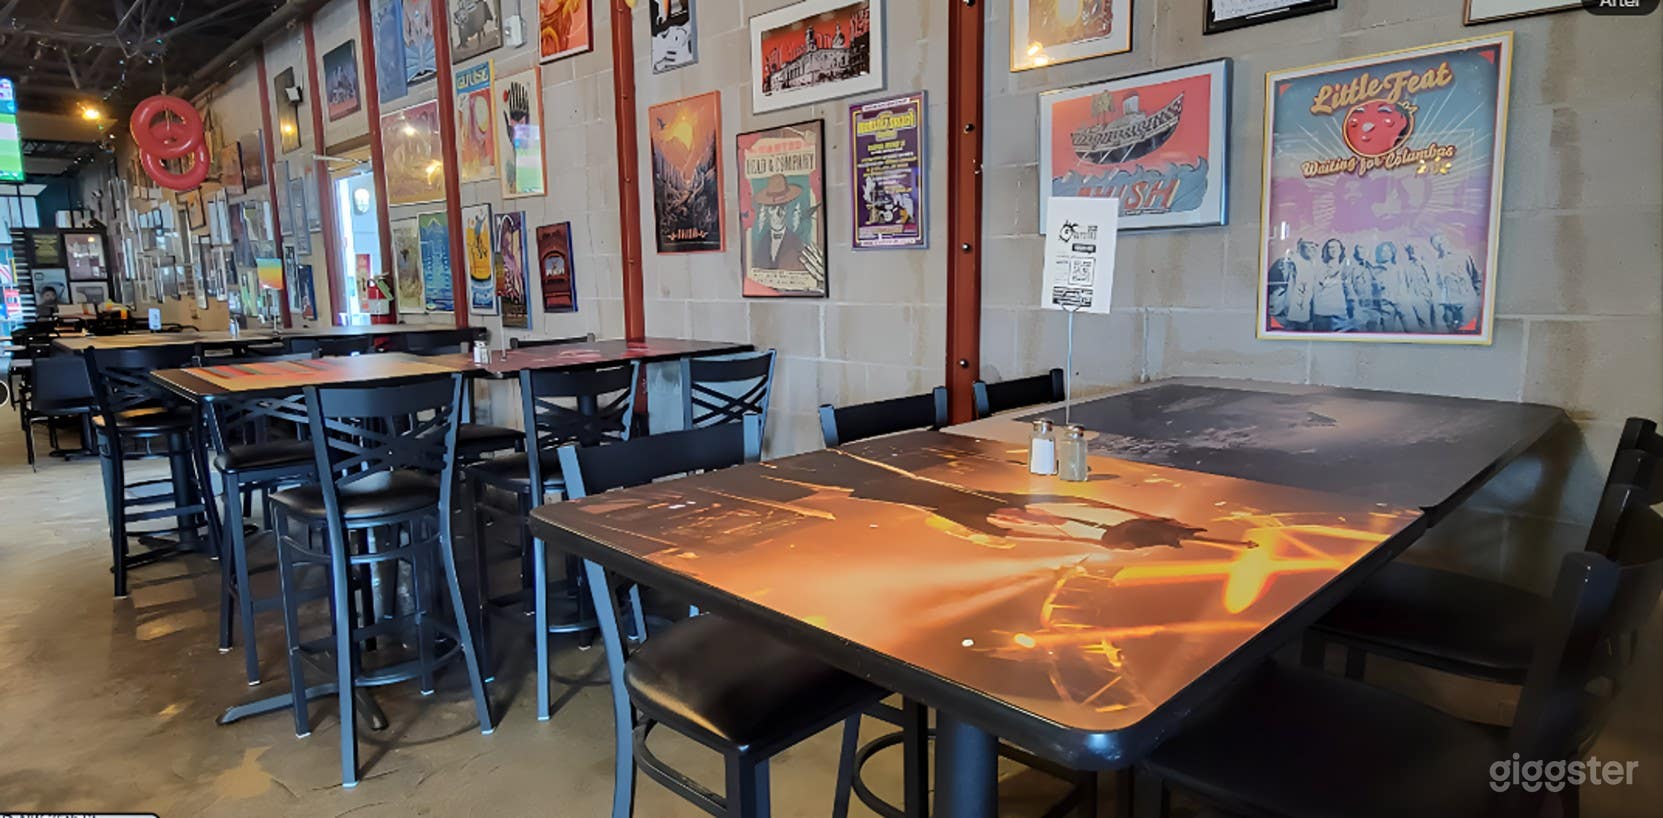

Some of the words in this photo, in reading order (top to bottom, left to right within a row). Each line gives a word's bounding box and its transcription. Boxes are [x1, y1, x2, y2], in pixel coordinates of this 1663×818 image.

[1310, 73, 1383, 115] Little
[1383, 61, 1453, 105] Feat
[775, 152, 815, 174] COMPANY
[1301, 157, 1357, 178] Waiting
[1358, 155, 1384, 178] for
